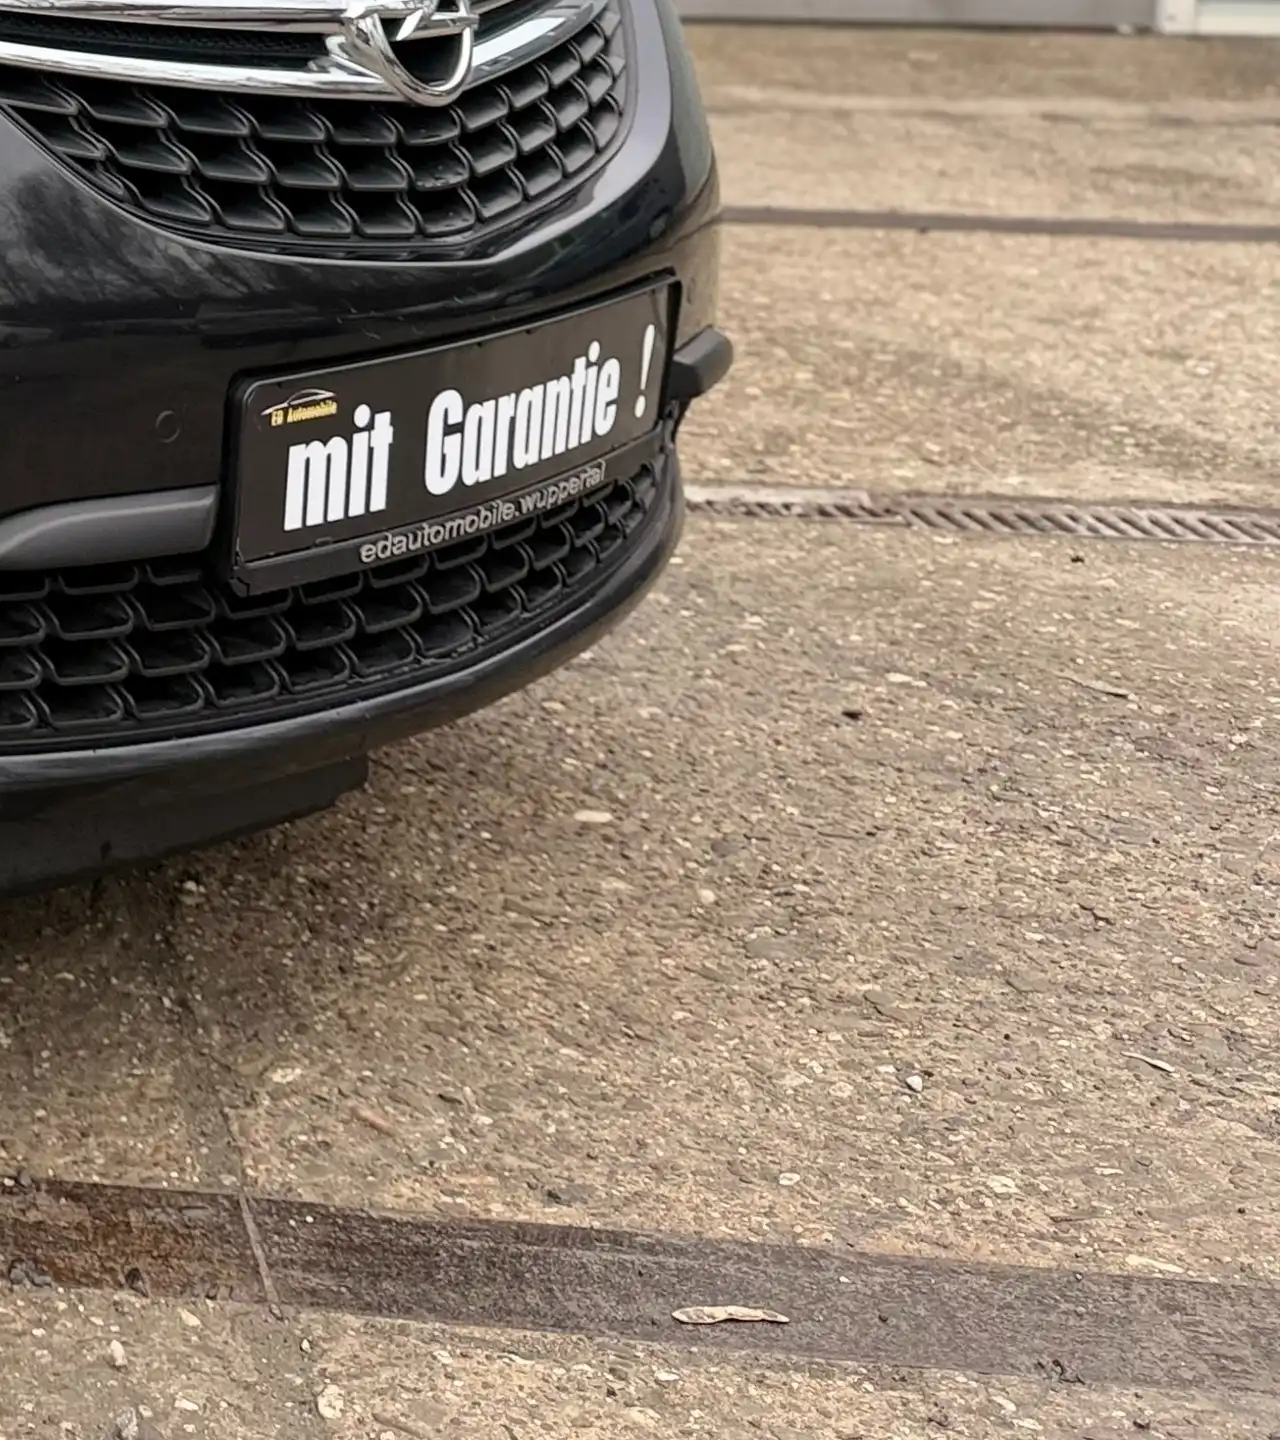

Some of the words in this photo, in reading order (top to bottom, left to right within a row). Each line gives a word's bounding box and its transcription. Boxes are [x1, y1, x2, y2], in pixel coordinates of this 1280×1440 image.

[271, 410, 284, 427] ED
[287, 400, 338, 424] Automobile
[283, 403, 394, 532] mit
[424, 340, 621, 496] Garantie
[359, 459, 607, 563] edautomobile.wuppertal
